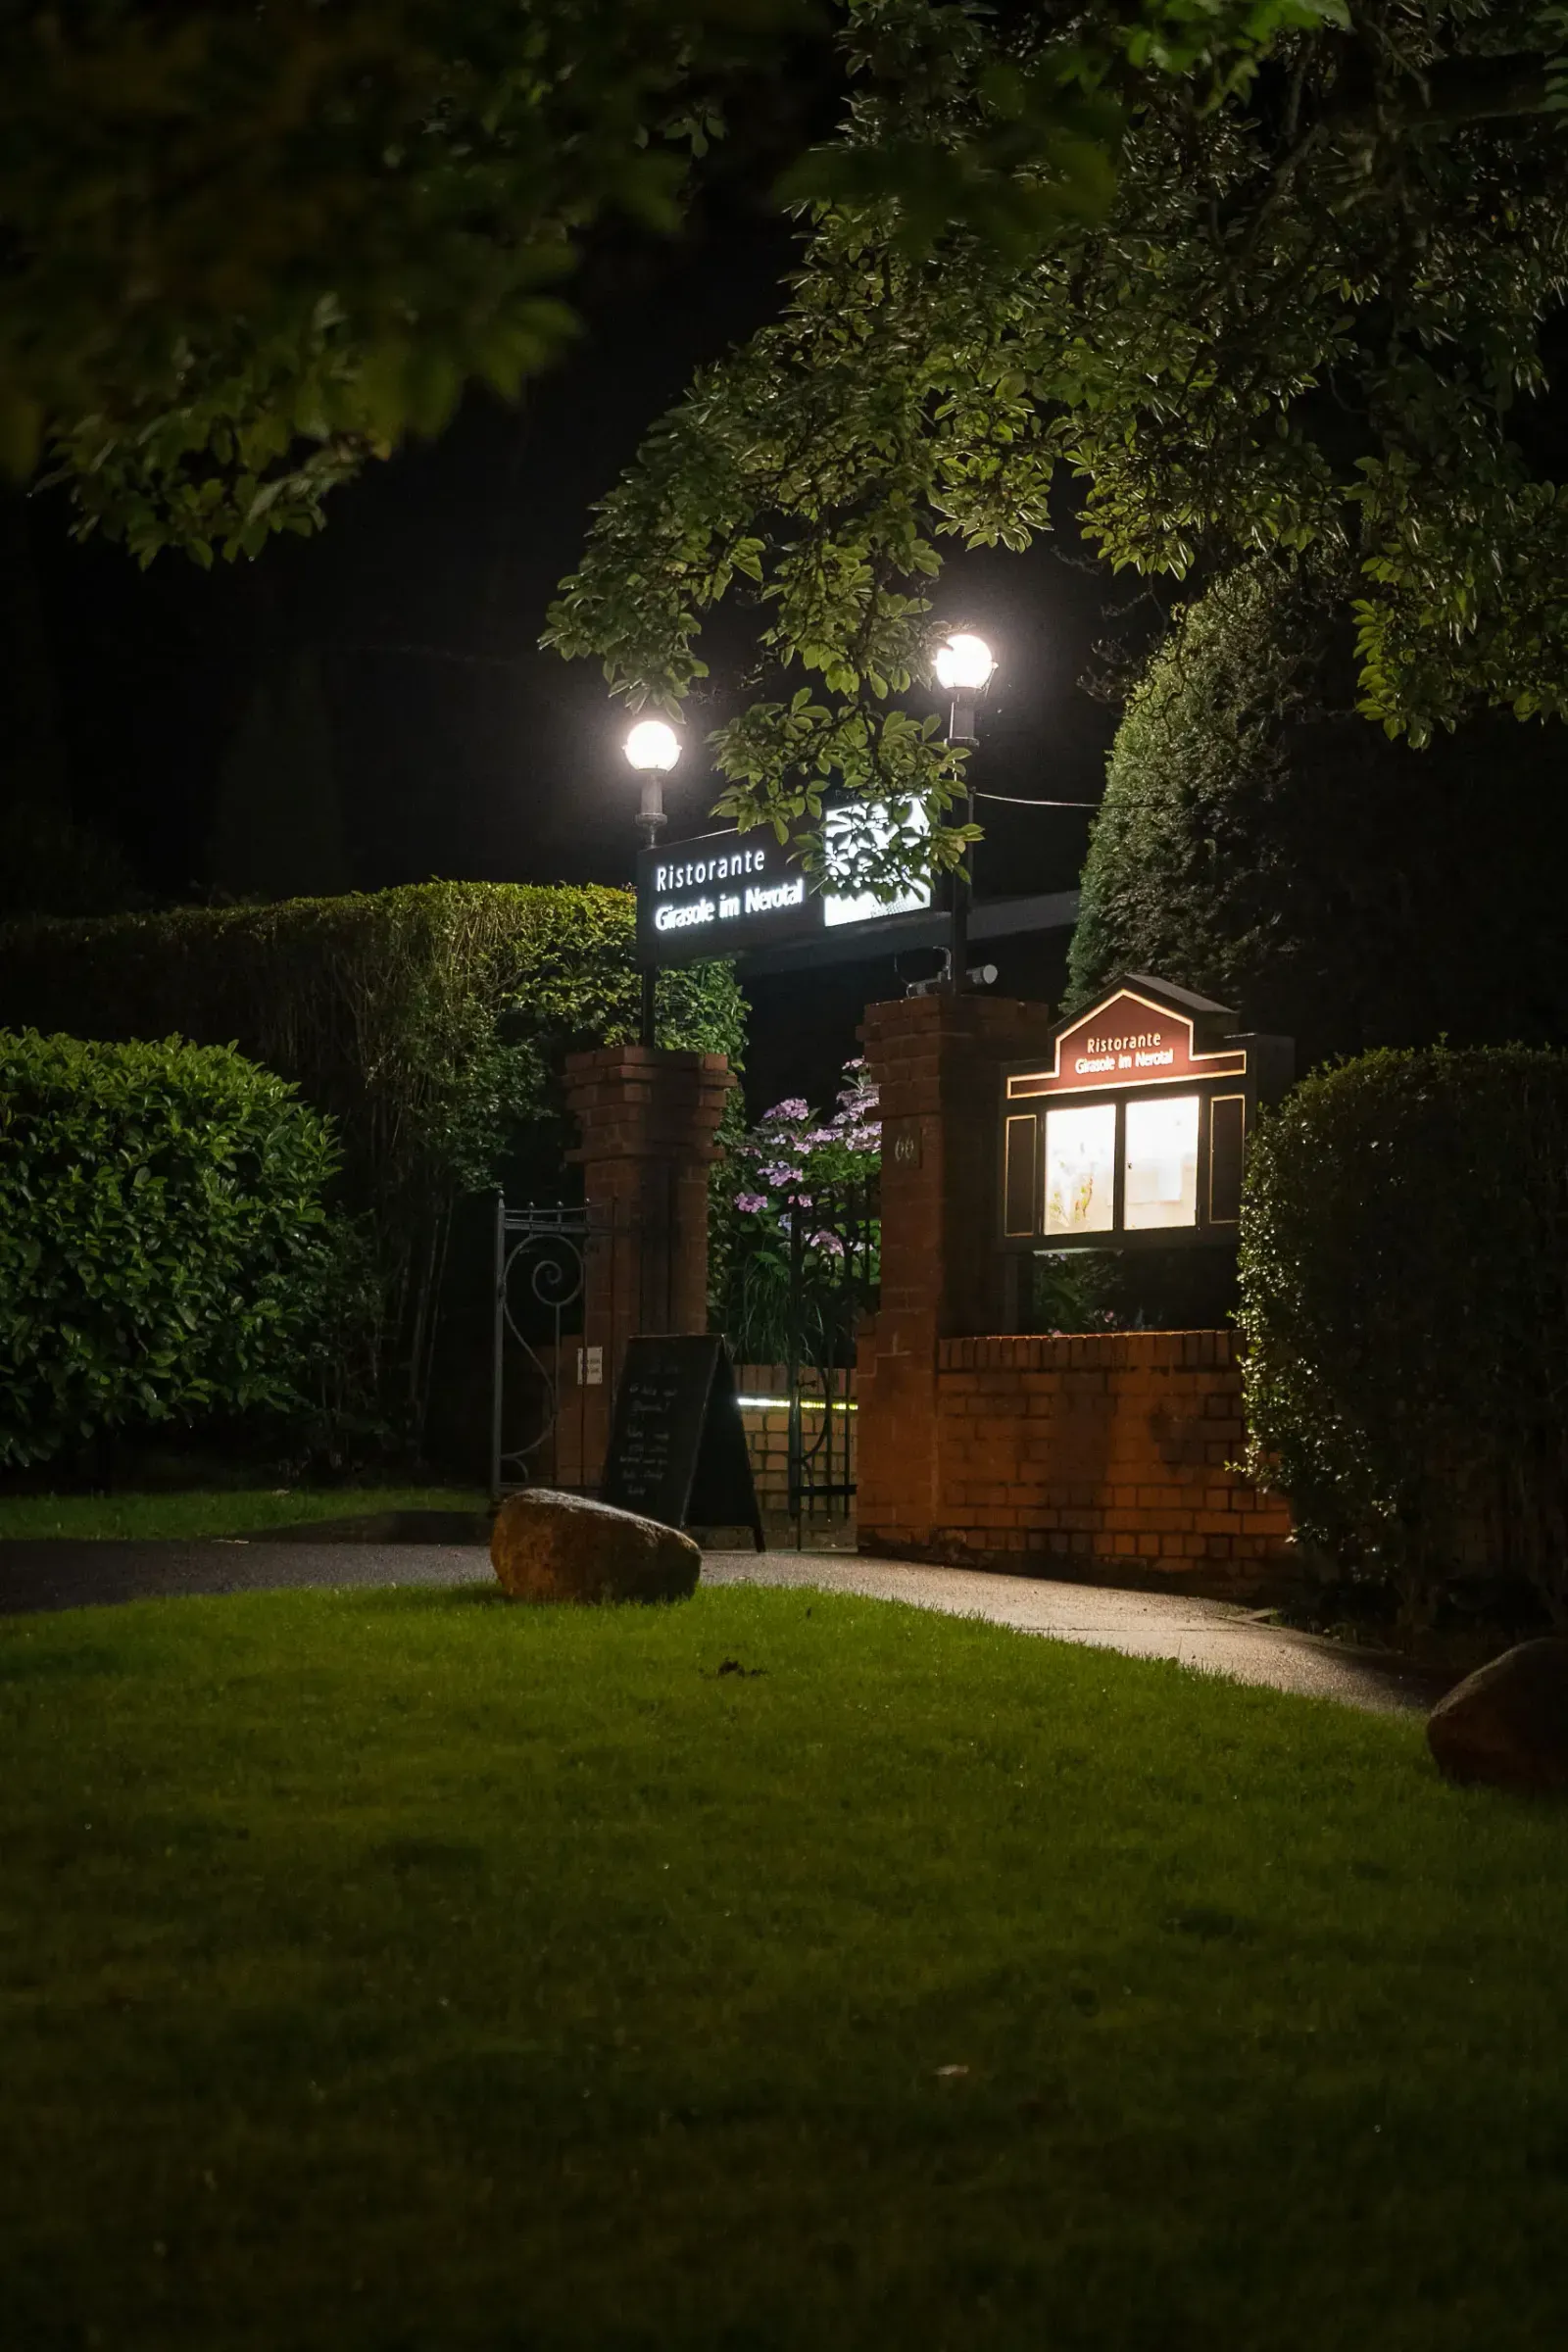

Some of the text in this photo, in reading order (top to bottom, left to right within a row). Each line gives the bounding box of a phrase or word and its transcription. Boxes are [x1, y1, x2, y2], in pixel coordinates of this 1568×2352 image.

[656, 849, 766, 892] Ristorante
[655, 878, 804, 931] Girasole im Nerotal
[1087, 1032, 1161, 1054] Ristorante
